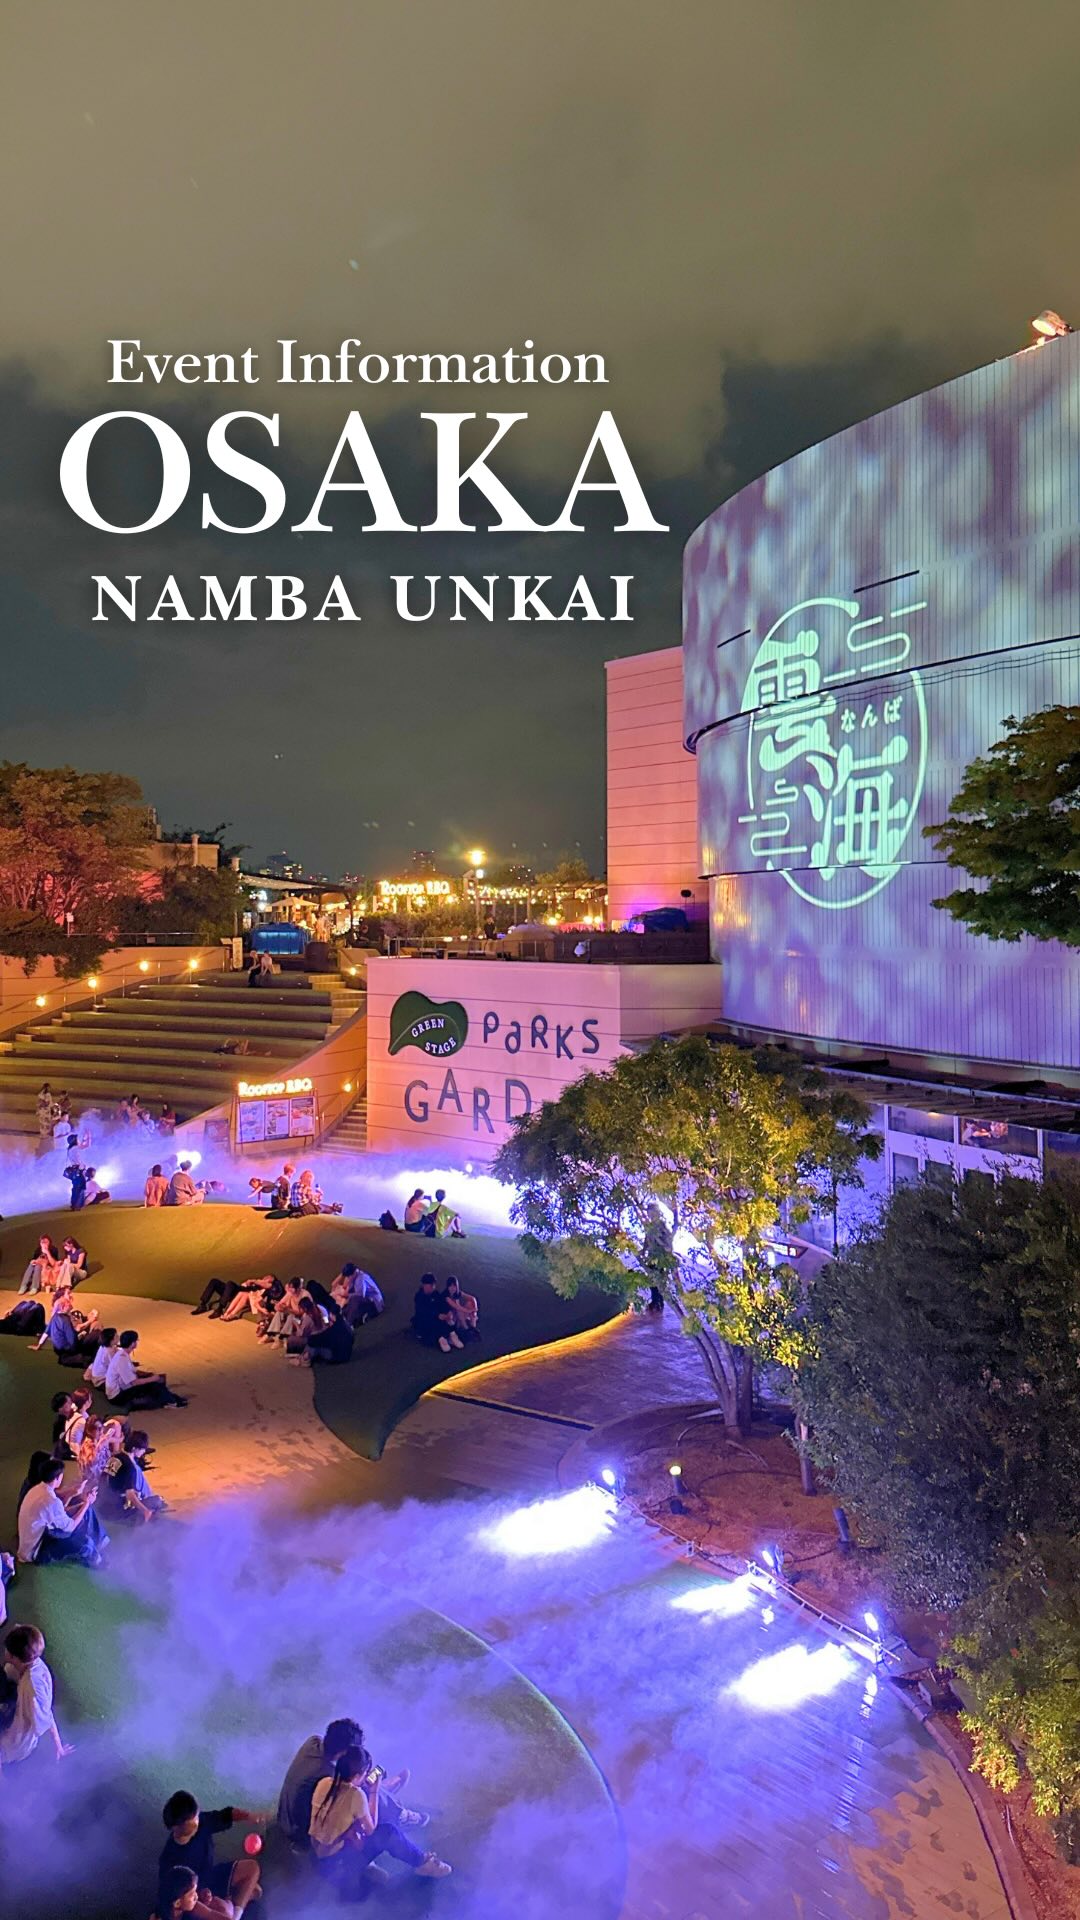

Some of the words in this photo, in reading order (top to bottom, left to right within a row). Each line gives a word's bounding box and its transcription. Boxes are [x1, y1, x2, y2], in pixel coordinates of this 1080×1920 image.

[840, 695, 903, 734] なんば
[411, 1018, 445, 1038] GREEN
[425, 1036, 457, 1055] STAGE
